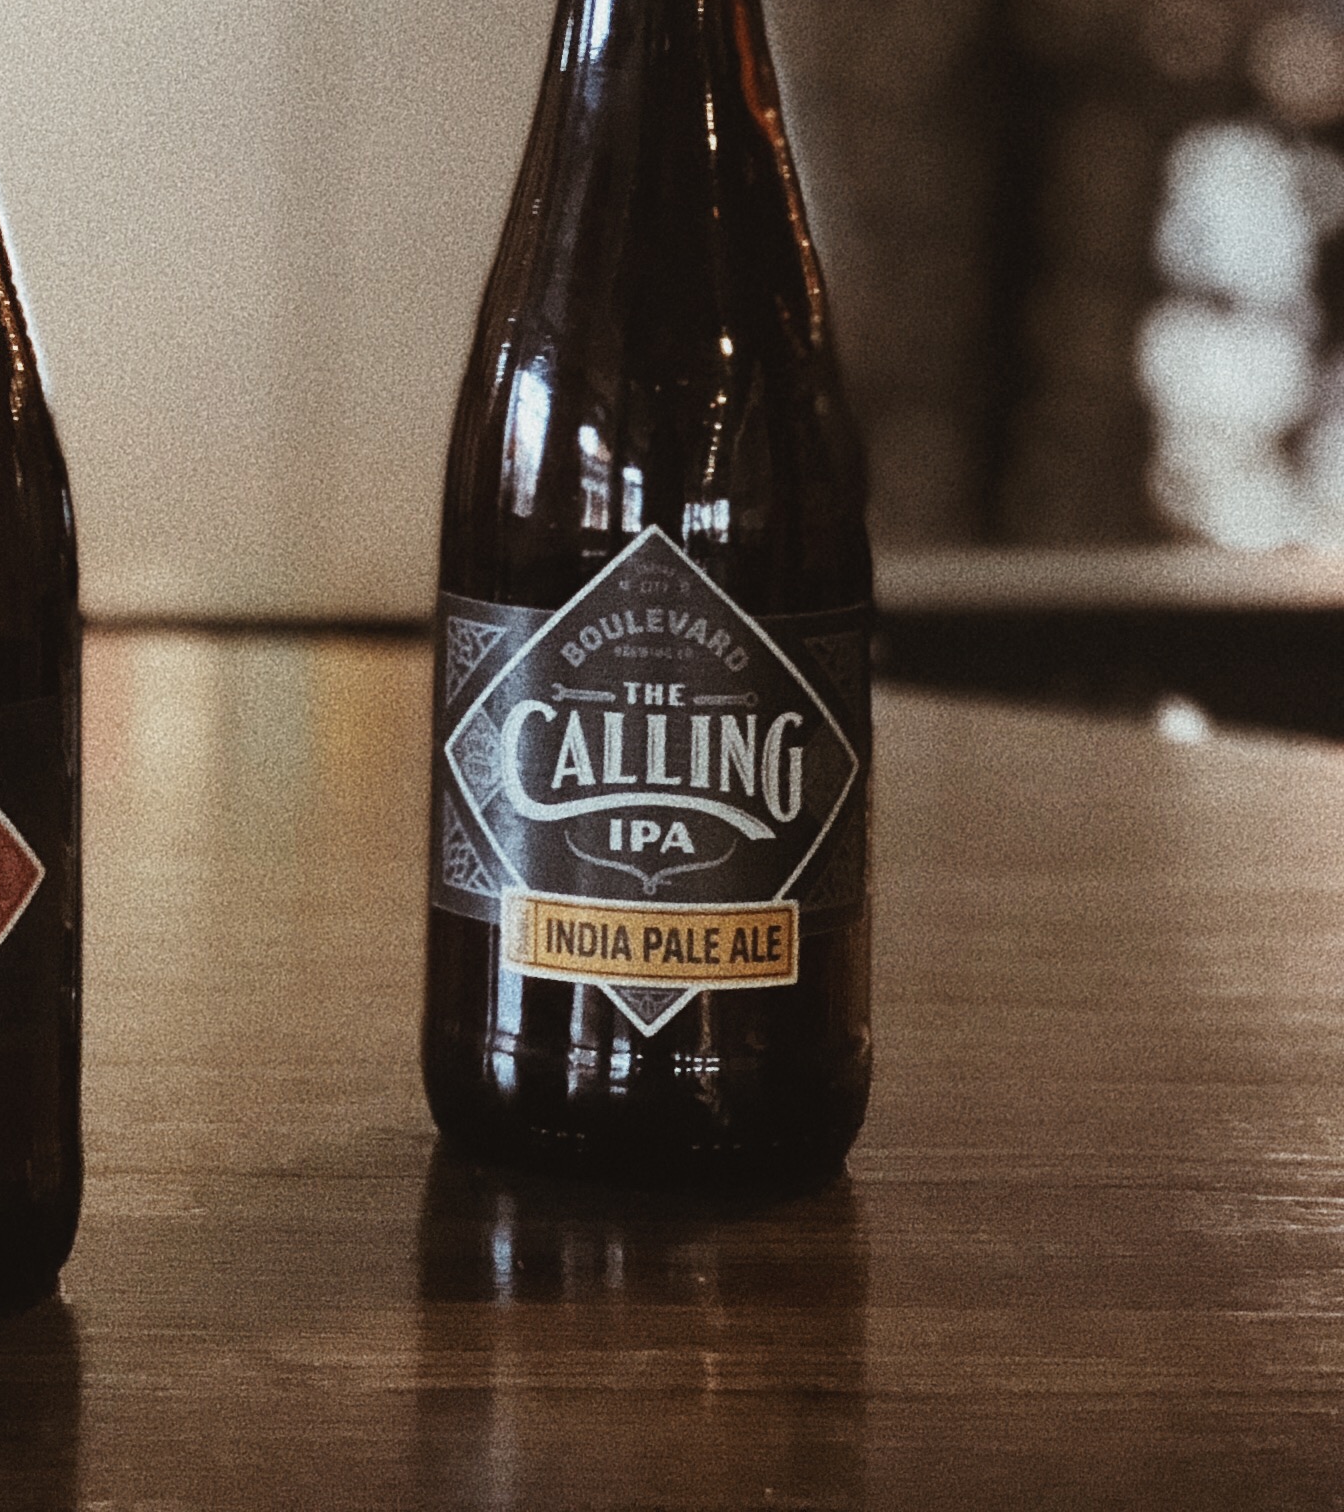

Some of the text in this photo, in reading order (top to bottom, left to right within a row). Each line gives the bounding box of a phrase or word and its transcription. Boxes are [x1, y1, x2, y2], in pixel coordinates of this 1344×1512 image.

[560, 608, 750, 673] BOULEVARD
[623, 681, 686, 707] THE
[501, 699, 803, 824] CALLING
[609, 818, 695, 854] IPA
[546, 917, 632, 963] INDIA
[643, 926, 720, 965] PALE
[730, 924, 783, 964] ALE
